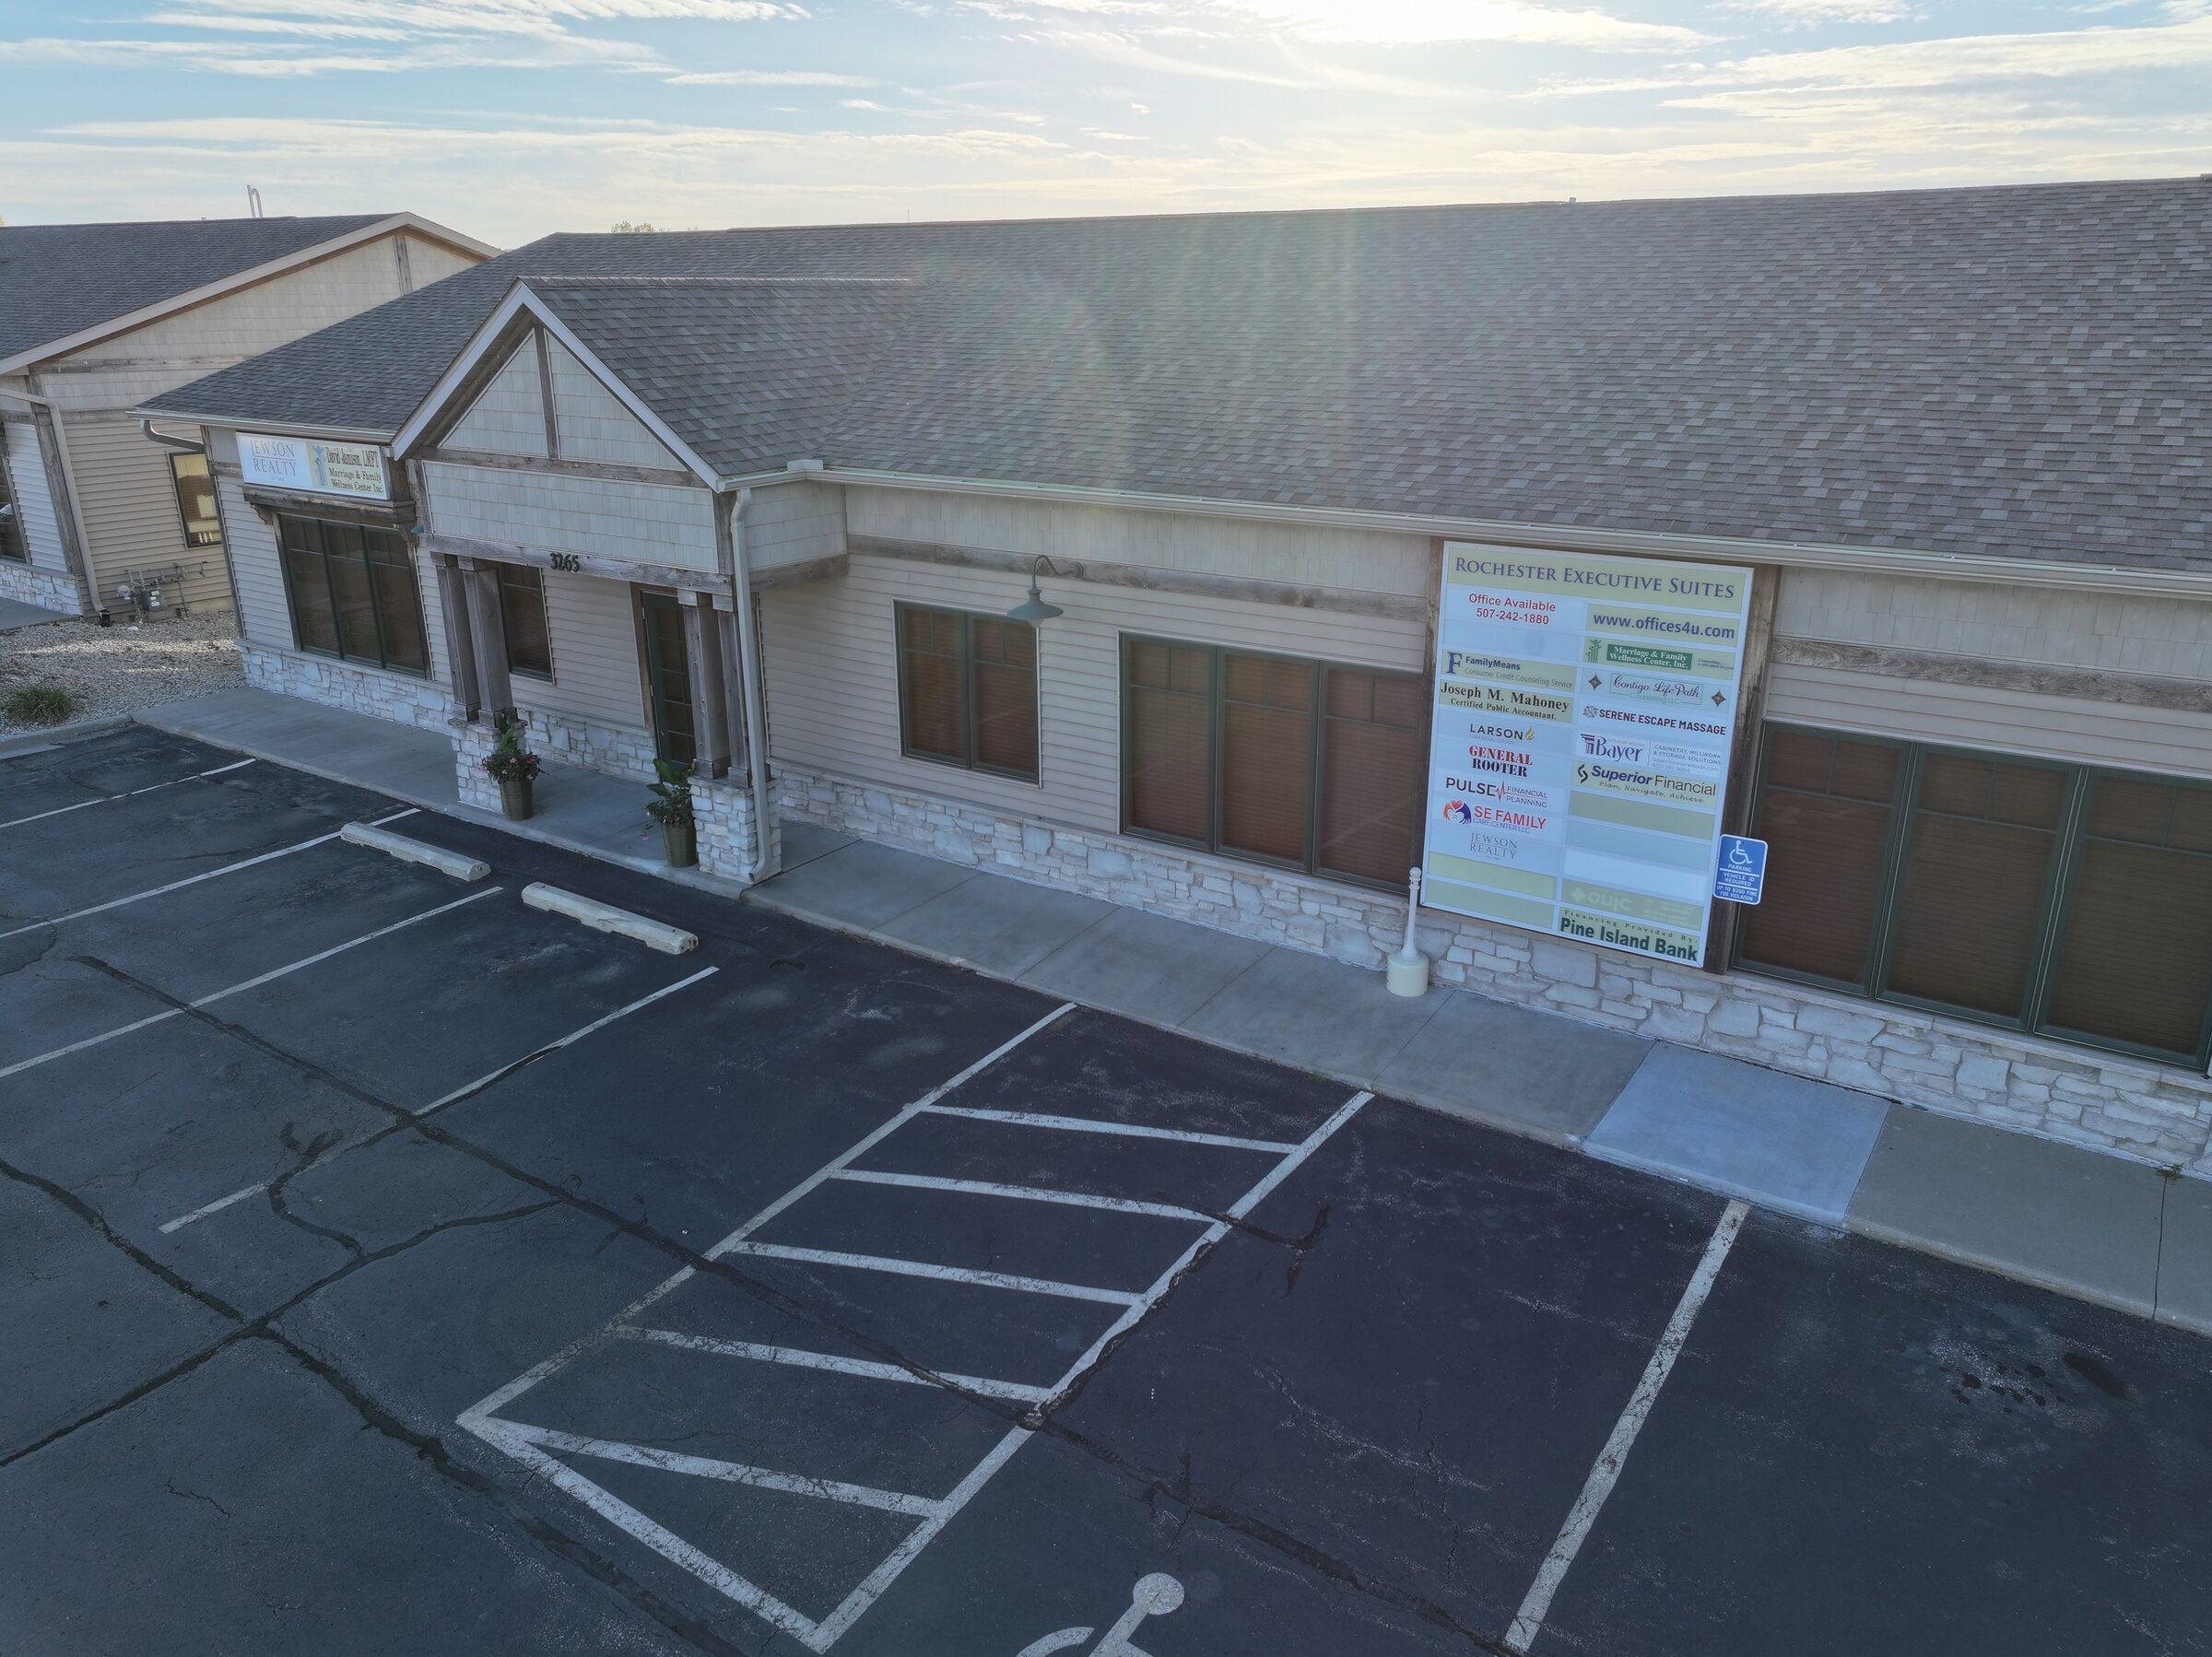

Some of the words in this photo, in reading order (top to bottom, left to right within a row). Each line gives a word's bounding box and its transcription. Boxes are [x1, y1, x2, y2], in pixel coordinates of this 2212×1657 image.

[251, 441, 295, 457] JEWSON
[253, 458, 295, 476] REALTY
[328, 466, 354, 480] Marriage
[356, 470, 360, 479] &
[362, 471, 382, 483] Family
[331, 479, 353, 489] Wellness
[355, 481, 371, 492] Center
[1455, 557, 1556, 582] ROCHESTER
[1564, 568, 1663, 592] EXECUTIVE
[1668, 577, 1735, 599] SUITES
[1469, 593, 1500, 606] Office
[1504, 597, 1556, 612] Available
[1477, 608, 1549, 625] 507-242-1880
[1594, 614, 1735, 639] www.offices4u.com
[1465, 656, 1521, 671] FamilyMeans
[1609, 653, 1641, 663] Wellness
[1674, 660, 1688, 669] Inc.
[1614, 647, 1650, 656] Marriage
[1661, 652, 1687, 663] Family
[1465, 667, 1495, 677] Consumer
[1496, 672, 1515, 680] Credit
[1516, 675, 1549, 687] Counseling
[1441, 682, 1481, 699] Joseph
[1488, 688, 1504, 700] M.
[1511, 691, 1570, 712] Mahoney
[1451, 699, 1482, 709] Certified
[1486, 704, 1510, 713] Public
[1512, 708, 1556, 720] Accountant.
[1600, 710, 1635, 723] SERENE
[1639, 715, 1677, 728] ESCAPE
[1679, 721, 1726, 735] MASSAGE
[1470, 723, 1523, 740] LARSON
[1469, 745, 1533, 765] GENERAL
[1596, 736, 1644, 761] Bayer
[1472, 758, 1527, 777] ROOTER
[1688, 756, 1722, 765] SOLUTIONS
[1446, 778, 1497, 796] PULSE
[1508, 785, 1548, 798] FINANCIAL
[1591, 766, 1653, 785] Superior
[1654, 775, 1716, 796] Financial
[1600, 781, 1620, 790] Plan,
[1670, 793, 1703, 803] Achieve
[1506, 796, 1547, 807] PLANNING
[1475, 805, 1491, 819] SE
[1495, 810, 1547, 829] FAMILY
[1491, 820, 1517, 831] CENTER
[1471, 833, 1517, 848] JEWSON
[1471, 842, 1517, 859] REALTY
[1724, 872, 1746, 881] VEHICLE
[1728, 864, 1751, 872] PARKING
[1725, 877, 1751, 887] REQUIRED
[1731, 893, 1753, 901] VIOLATION
[1565, 910, 1618, 927] Financing
[1625, 923, 1673, 938] Provided
[1561, 917, 1594, 938] Pine
[1600, 925, 1650, 951] Island
[1655, 938, 1698, 962] Bank
